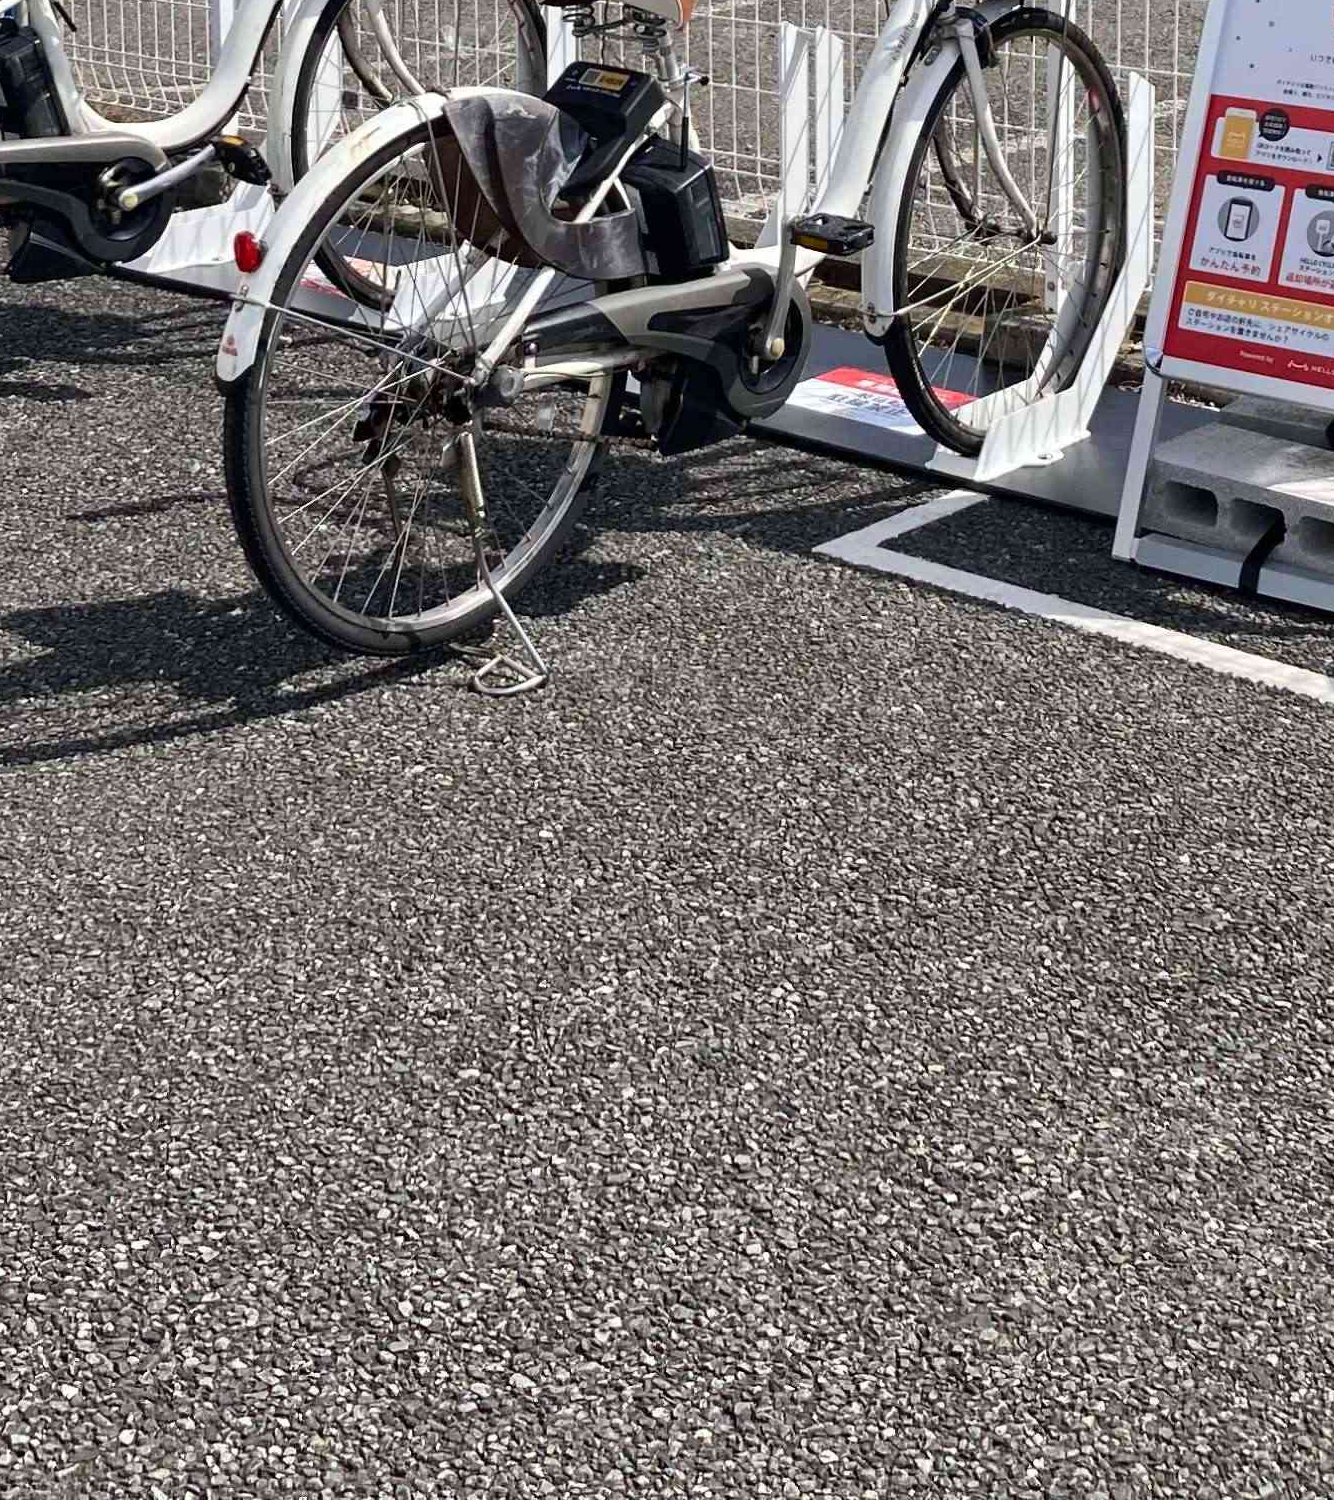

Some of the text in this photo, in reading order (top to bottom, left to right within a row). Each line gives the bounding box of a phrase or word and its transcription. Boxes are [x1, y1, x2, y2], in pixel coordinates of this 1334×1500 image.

[1199, 257, 1262, 277] かんたん予約
